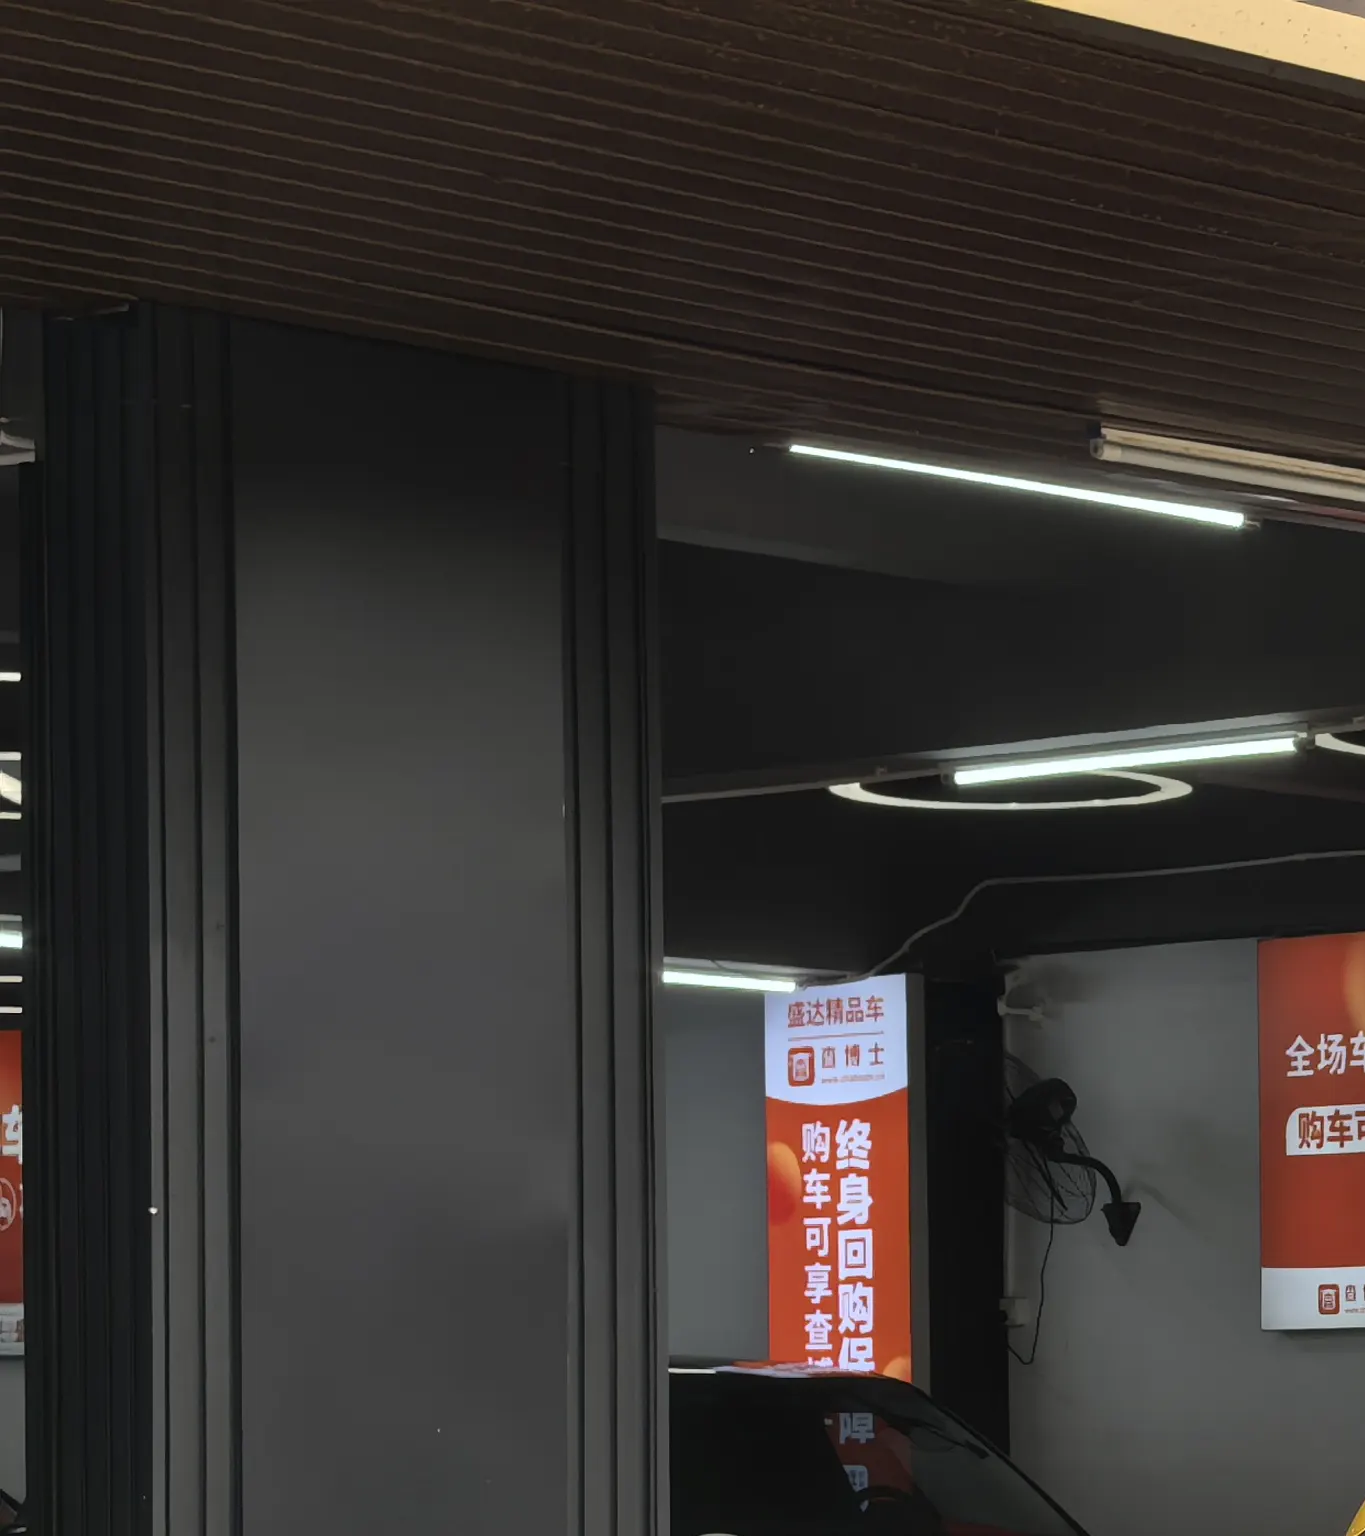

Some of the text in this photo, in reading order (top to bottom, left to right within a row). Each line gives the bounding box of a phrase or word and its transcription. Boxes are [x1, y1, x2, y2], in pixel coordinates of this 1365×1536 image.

[787, 995, 885, 1029] 盛达精品车
